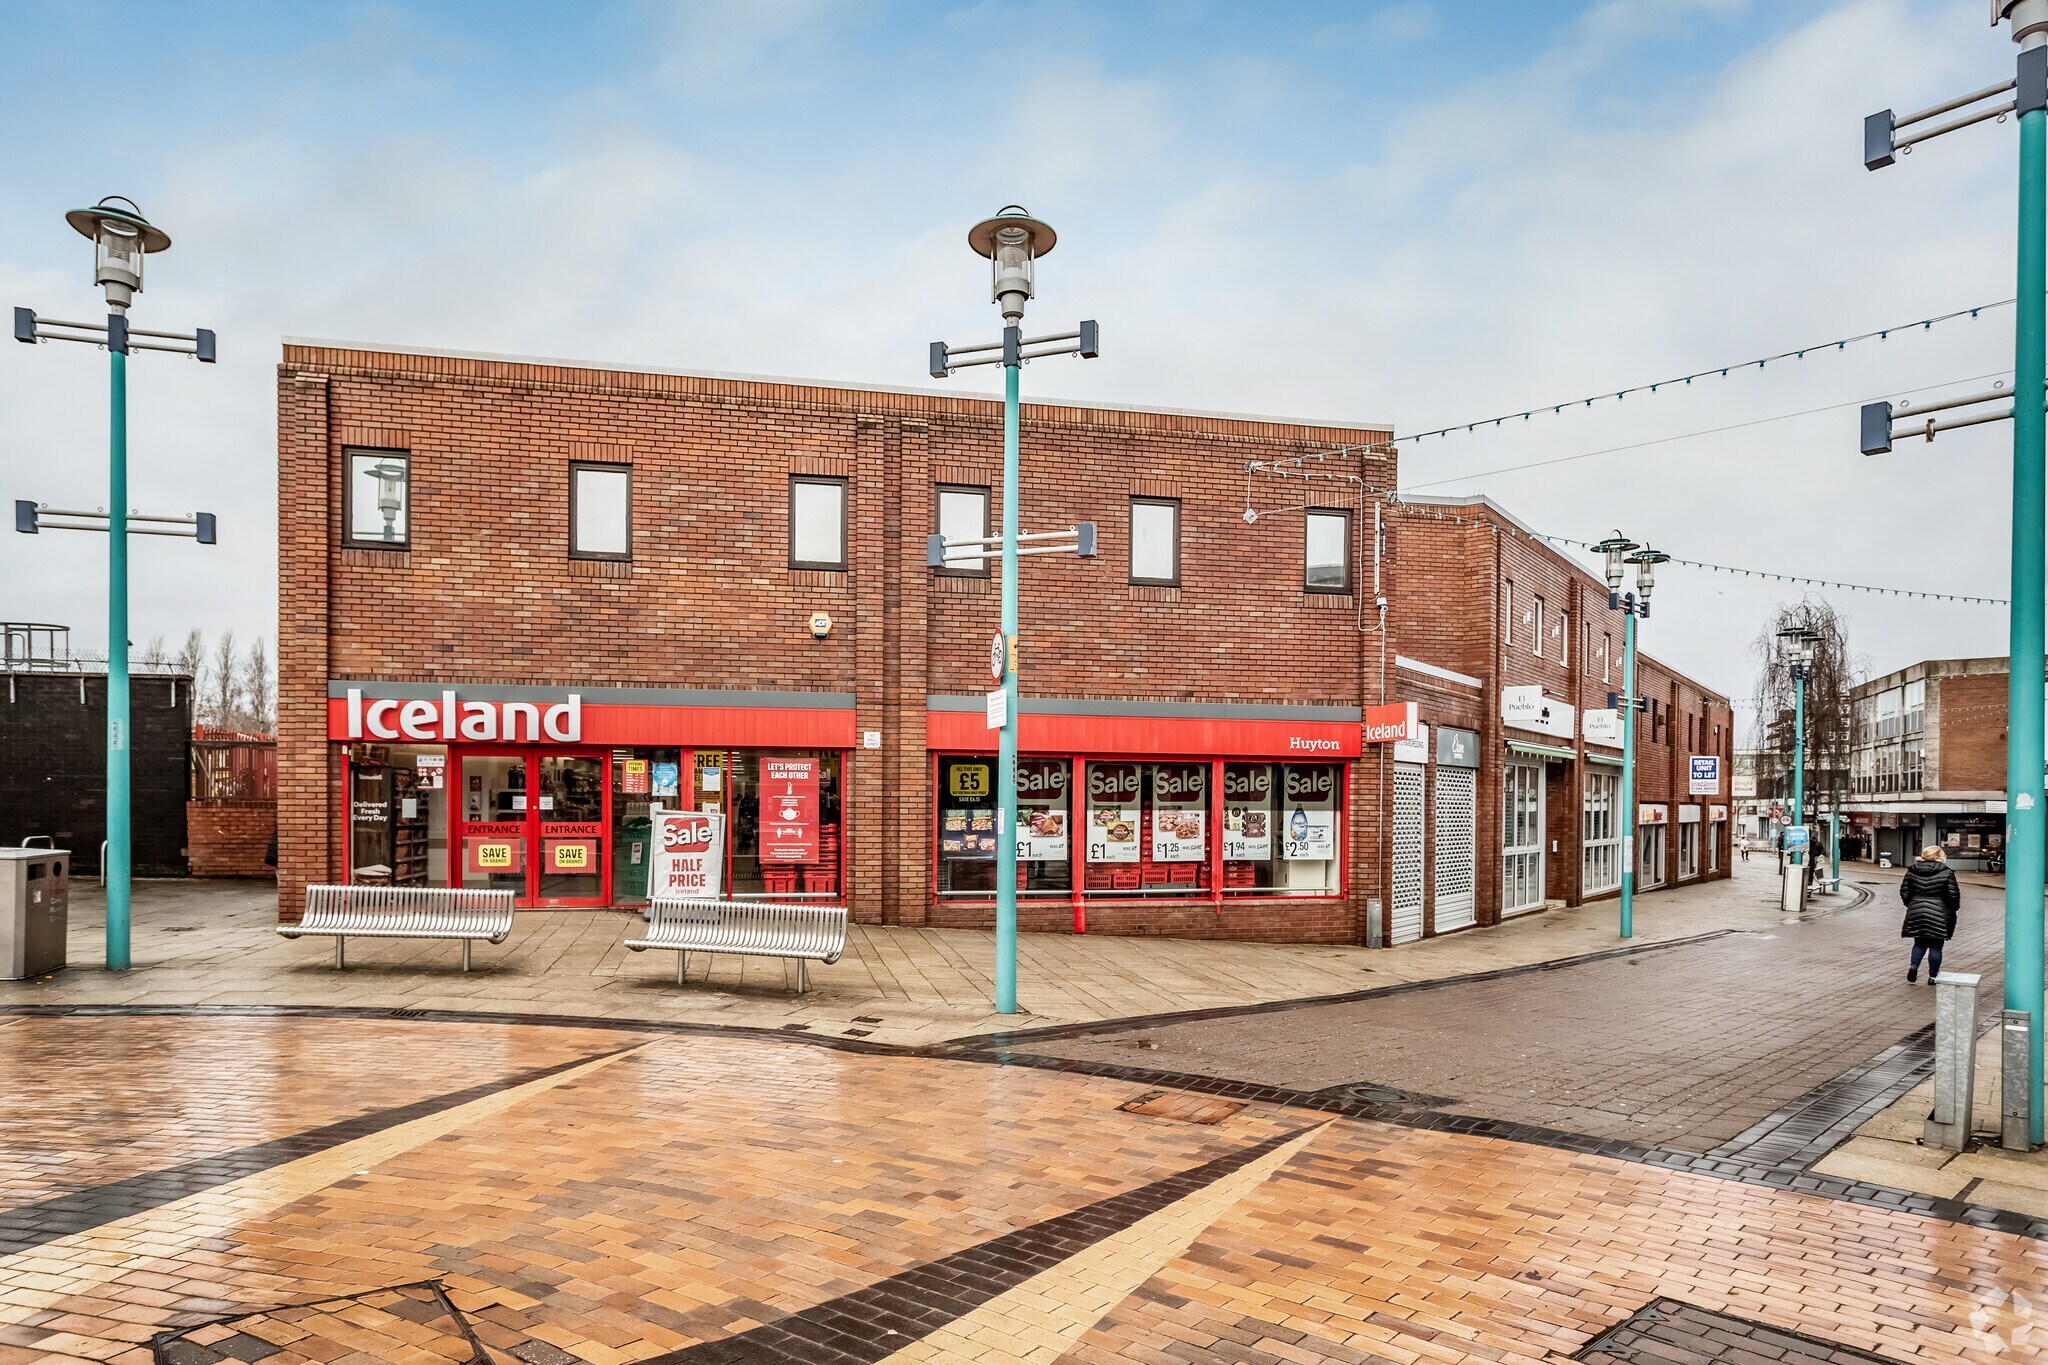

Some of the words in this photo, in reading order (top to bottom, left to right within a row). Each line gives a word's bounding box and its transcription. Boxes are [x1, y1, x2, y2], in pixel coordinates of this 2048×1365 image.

[1508, 702, 1534, 710] Pueblo
[348, 688, 581, 742] Iceland
[1366, 720, 1405, 740] Iceland
[1290, 736, 1340, 752] Huyton
[959, 772, 980, 790] £5
[1017, 766, 1066, 792] Sale
[1089, 770, 1140, 795] Sale
[1154, 770, 1204, 795] Sale
[1224, 770, 1270, 794] Sale
[1285, 770, 1332, 795] Sale
[468, 825, 521, 834] ENTRANCE
[545, 825, 597, 834] ENTRANCE
[662, 821, 713, 847] Sale
[482, 848, 507, 858] SAVE
[559, 849, 583, 859] SAVE
[1016, 842, 1032, 858] £1
[1091, 843, 1106, 859] £1
[1157, 842, 1180, 858] £1.25
[1224, 842, 1245, 857] £1.94
[1286, 842, 1309, 857] £2.50
[672, 859, 703, 872] HALF
[669, 874, 706, 887] PRICE
